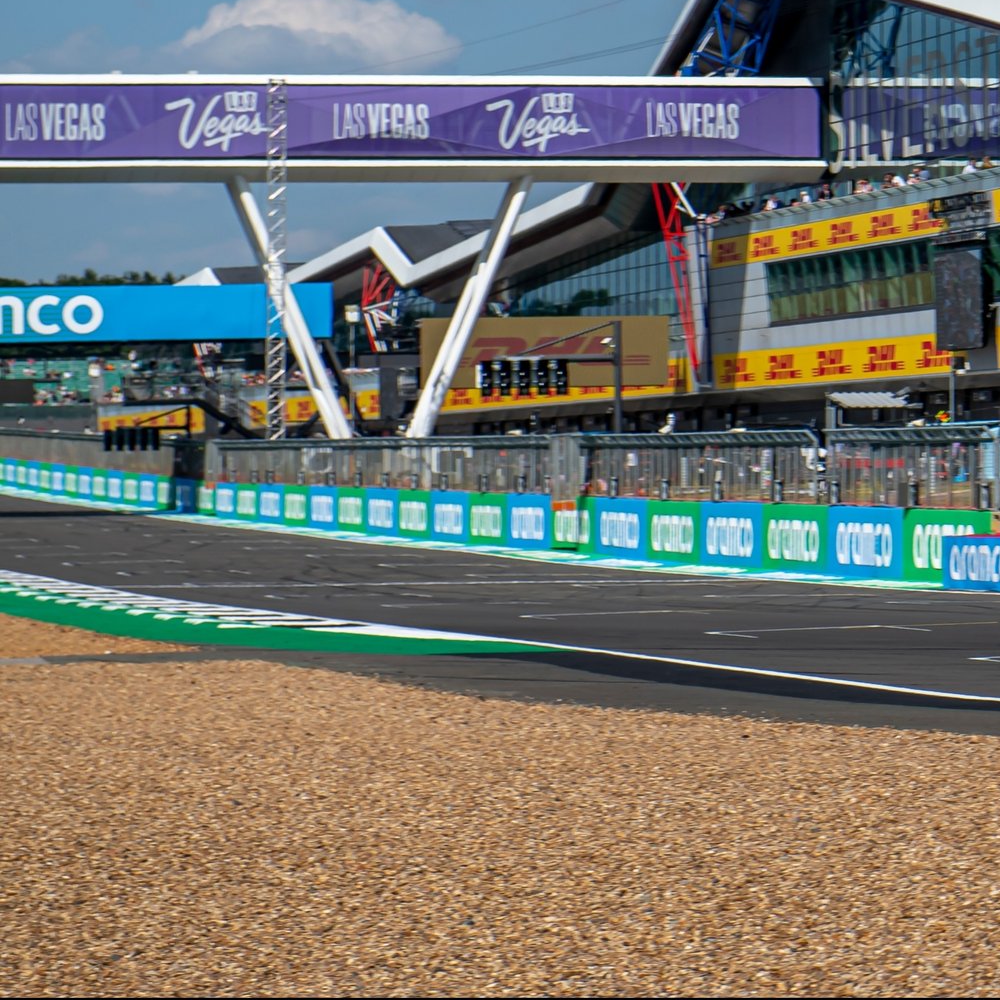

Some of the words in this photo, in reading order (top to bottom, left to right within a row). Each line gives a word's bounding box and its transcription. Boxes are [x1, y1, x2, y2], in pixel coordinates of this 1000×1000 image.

[5, 102, 38, 141] LAS
[40, 102, 106, 141] VEGAS
[165, 94, 268, 151] Vegas
[333, 102, 364, 139] LAS
[366, 102, 430, 140] VEGAS
[485, 96, 591, 152] Vegas
[646, 101, 678, 138] LAS
[679, 102, 740, 140] VEGAS
